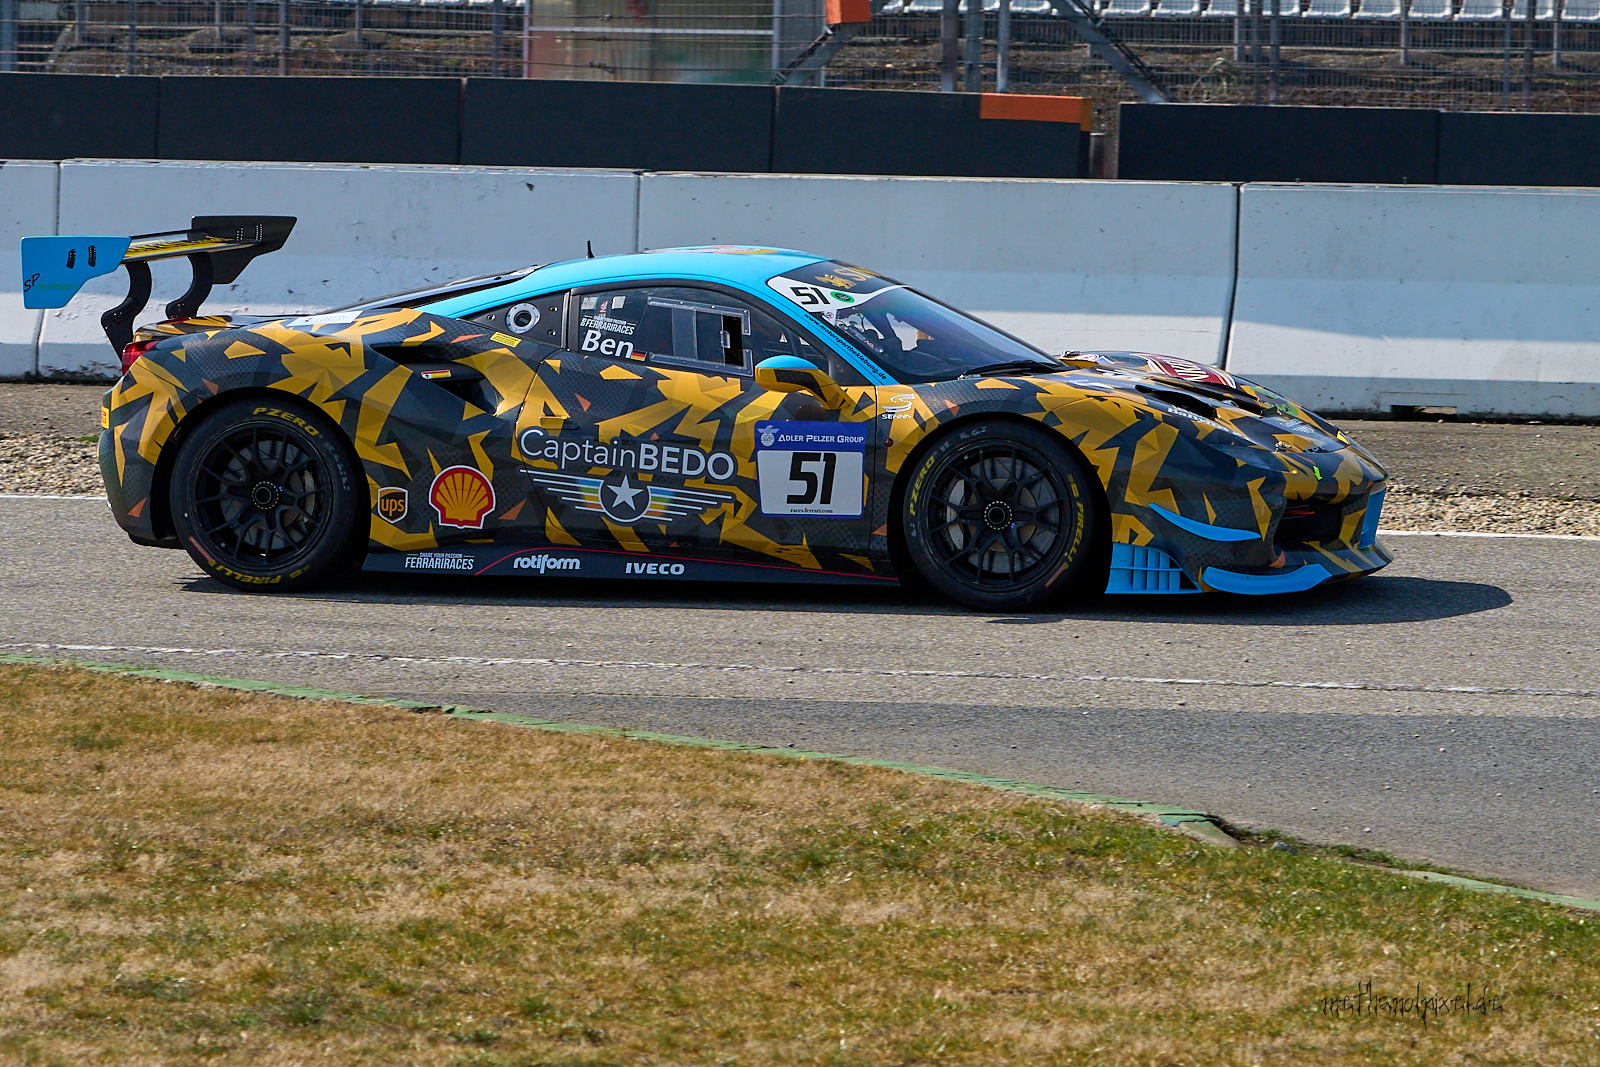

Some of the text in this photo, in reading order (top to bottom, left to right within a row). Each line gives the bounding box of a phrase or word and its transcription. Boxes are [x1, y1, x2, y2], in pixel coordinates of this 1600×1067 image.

[24, 272, 40, 292] SP
[790, 286, 831, 305] 51
[582, 329, 634, 359] Ben
[804, 313, 887, 380] www.motorsportbeklebung.de
[786, 452, 837, 505] 51
[381, 499, 405, 517] ups
[1067, 501, 1085, 563] PIRELLI
[405, 556, 474, 571] FERRARIRACES
[513, 554, 581, 574] rotiform
[625, 562, 685, 576] IVECO
[215, 565, 282, 584] PIRELLI
